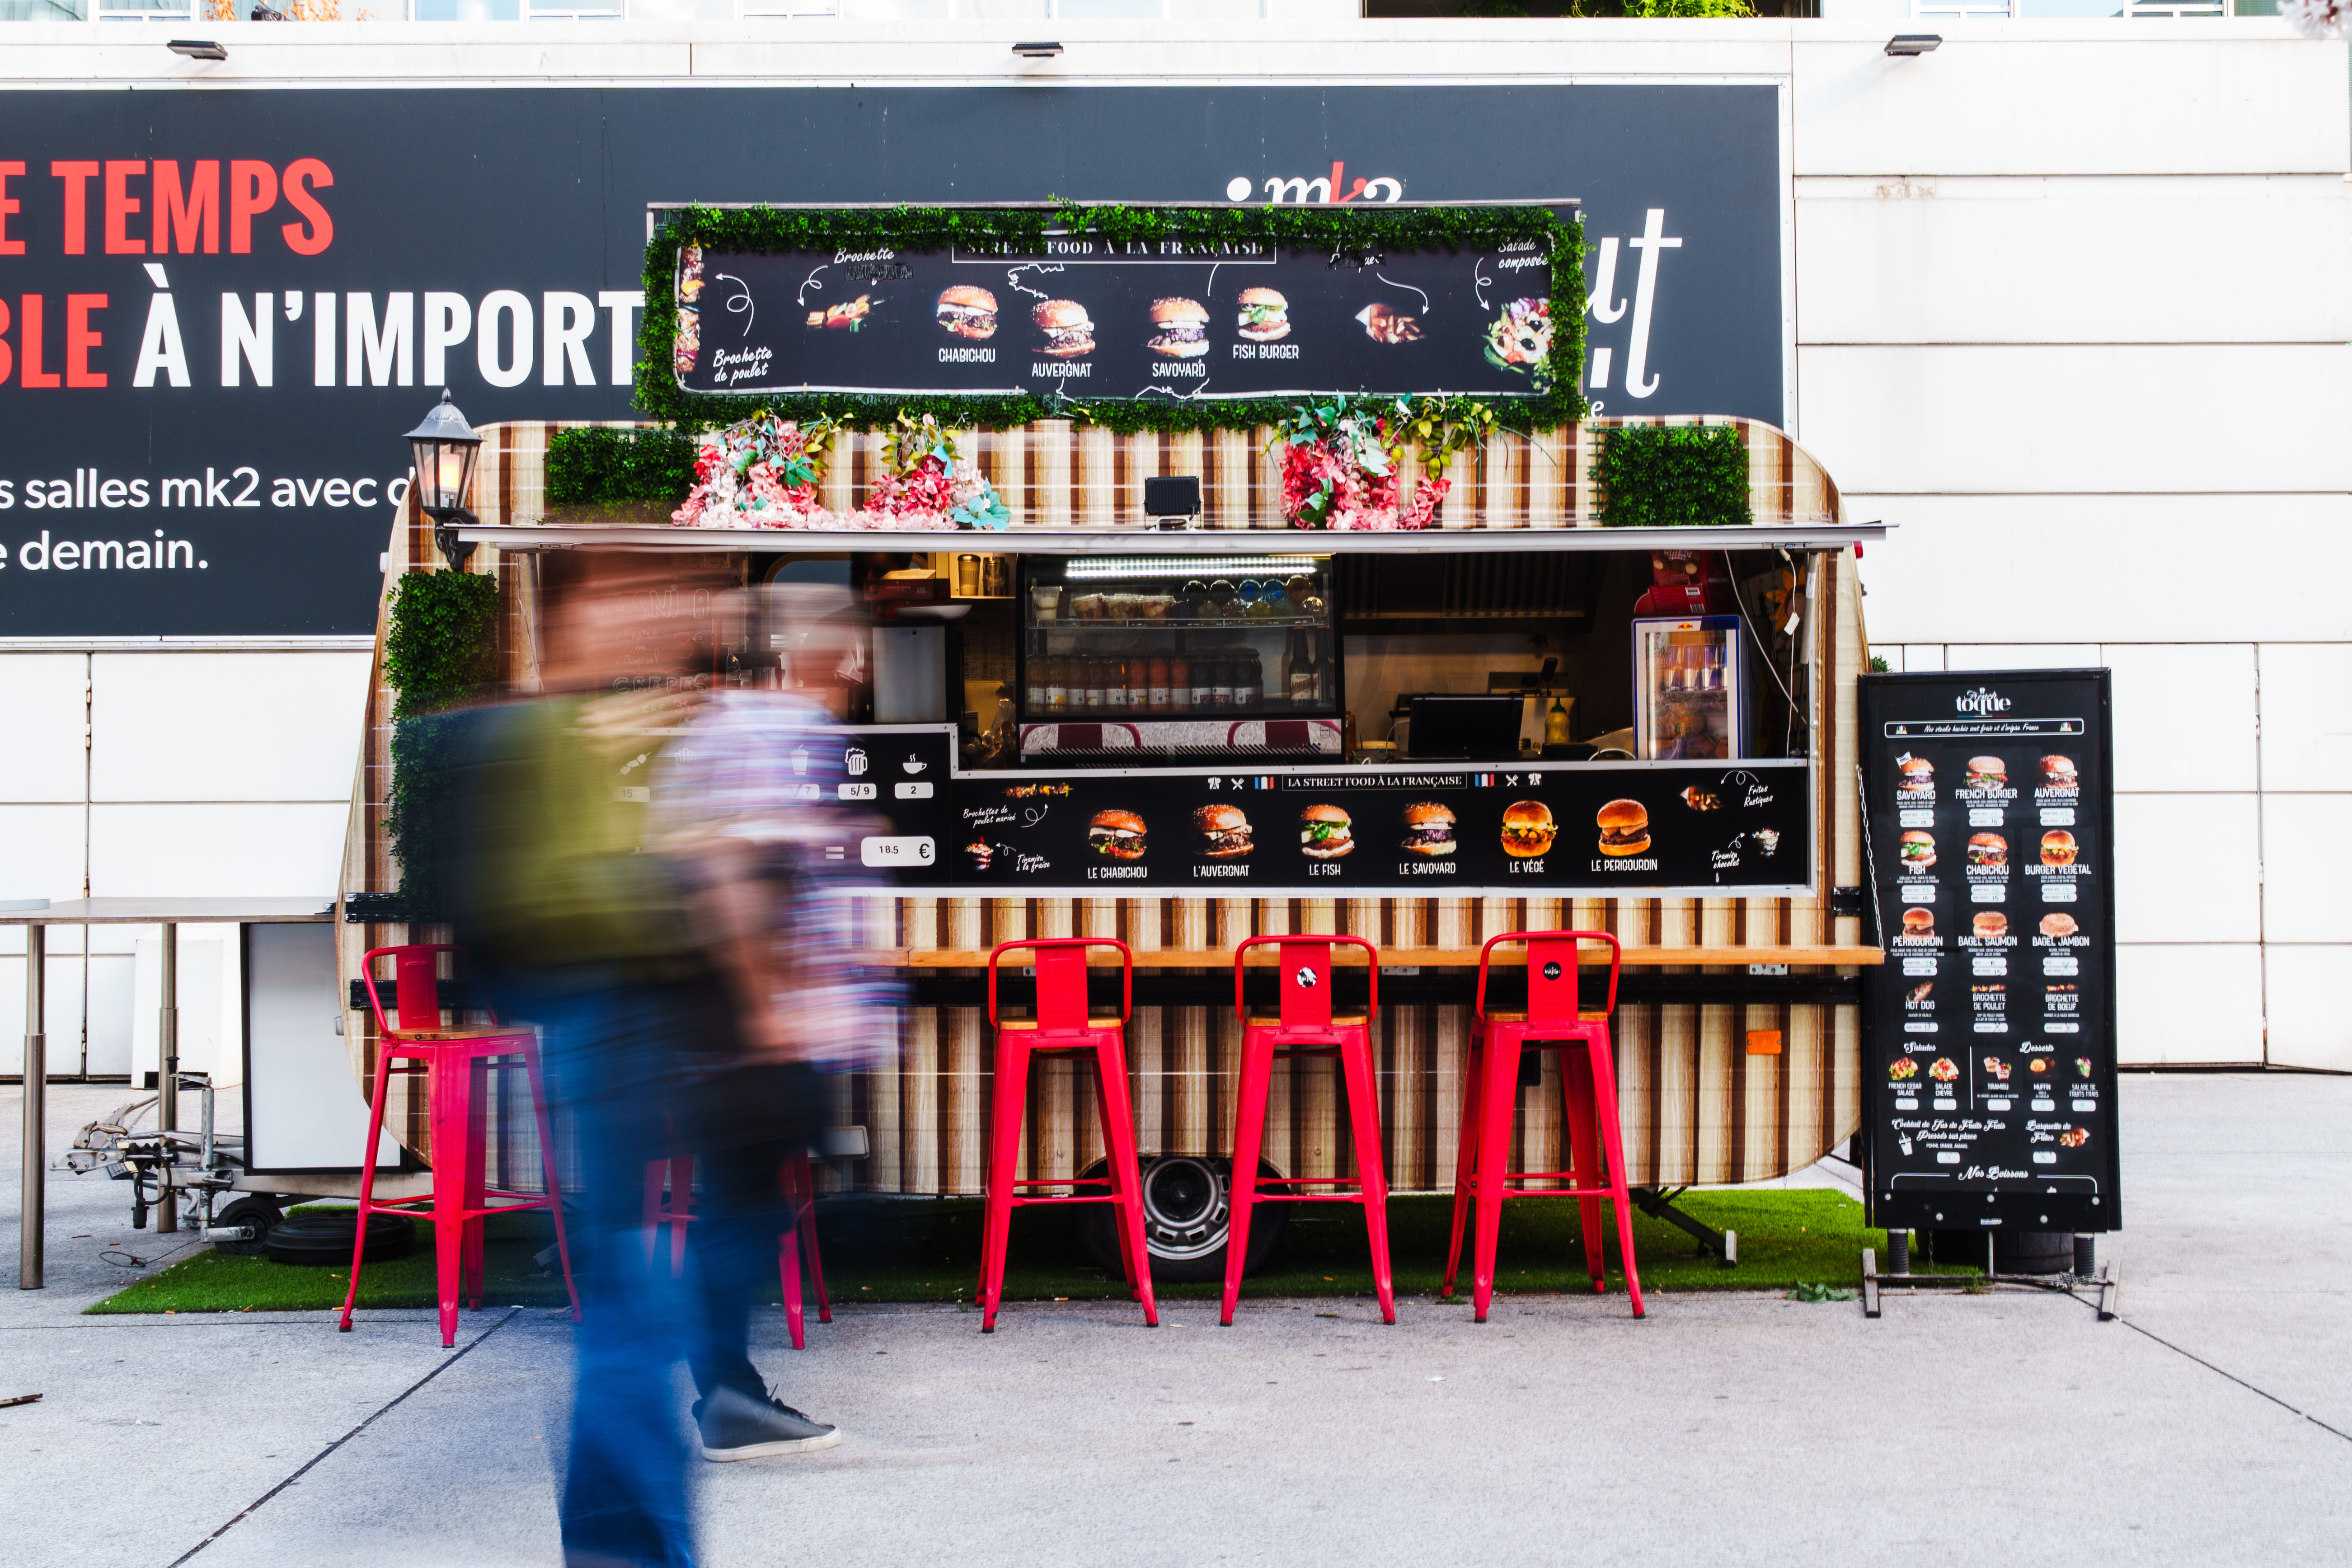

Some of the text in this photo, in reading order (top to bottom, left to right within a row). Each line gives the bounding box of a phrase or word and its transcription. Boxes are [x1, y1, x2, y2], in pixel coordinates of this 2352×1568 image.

[51, 158, 334, 256] TEMPS
[1047, 241, 1093, 254] FOOD
[1104, 239, 1114, 254] À
[1127, 241, 1148, 254] LA
[1498, 237, 1536, 253] Salade
[834, 247, 895, 265] Brochette
[1498, 251, 1549, 273] composée
[0, 294, 108, 388] LE
[133, 263, 191, 387] À
[713, 346, 773, 367] Brochette
[939, 347, 995, 362] CHABICHOU
[1233, 344, 1299, 359] FISH BURGER
[714, 362, 768, 386] de poulet
[1032, 362, 1092, 377] AUVERGNAT
[1152, 362, 1206, 377] SAVOYARD
[24, 468, 150, 508] salles
[163, 466, 260, 507] mk2
[271, 477, 377, 507] avec
[19, 529, 208, 570] demain.
[1956, 695, 2011, 715] toque
[1288, 775, 1462, 788] LA STREET FOOD À LA FRANÇAISE
[911, 786, 916, 794] 2
[1748, 784, 1768, 795] Frites
[1897, 789, 1935, 800] SAVOYARD
[1956, 788, 2017, 799] FRENCH BURGER
[2034, 787, 2080, 798] AUVERGNAT
[1744, 795, 1773, 807] Rustiques
[963, 805, 1008, 818] Brochettes de
[973, 813, 1016, 828] poulet mariné
[878, 843, 930, 859] 18.5 €
[1023, 862, 1029, 870] la
[1031, 862, 1050, 873] fraise
[1309, 864, 1341, 876] LE FISH
[1399, 862, 1456, 875] LE SAVOYARD
[1509, 859, 1544, 873] LE VÉGÉ
[1591, 859, 1657, 872] LE PERIGOURDIN
[1713, 859, 1740, 869] chocolat
[1909, 864, 1925, 875] FISH
[1967, 864, 2009, 875] CHABICHOU
[2025, 864, 2055, 875] BURGER
[1088, 867, 1147, 879] LE CHABICHOU
[1193, 864, 1249, 878] L'AUVERGNAT
[1893, 934, 1943, 946] PÉRIGOURDIN
[1958, 935, 2017, 946] BAGEL SAUMON
[2033, 936, 2089, 946] BAGEL JAMBON
[1973, 993, 2006, 1001] BROCHETTE
[2045, 993, 2079, 1002] BROCHETTE
[1906, 1000, 1935, 1009] HOT DOG
[1974, 1002, 2005, 1010] DE POULET
[2048, 1002, 2076, 1010] DE BOEUF
[1904, 1041, 1936, 1053] Salades
[2019, 1040, 2054, 1053] Desserts
[1892, 1117, 1920, 1130] Cocktail
[1931, 1119, 1948, 1131] Jus
[1958, 1118, 1982, 1131] Fruits
[1983, 1119, 2005, 1131] Frais
[2025, 1119, 2071, 1131] Barquette de
[1916, 1130, 1947, 1141] Pressés
[1959, 1131, 1977, 1141] place
[2031, 1131, 2054, 1143] Frites
[1958, 1165, 2028, 1180] Nos Boissons
